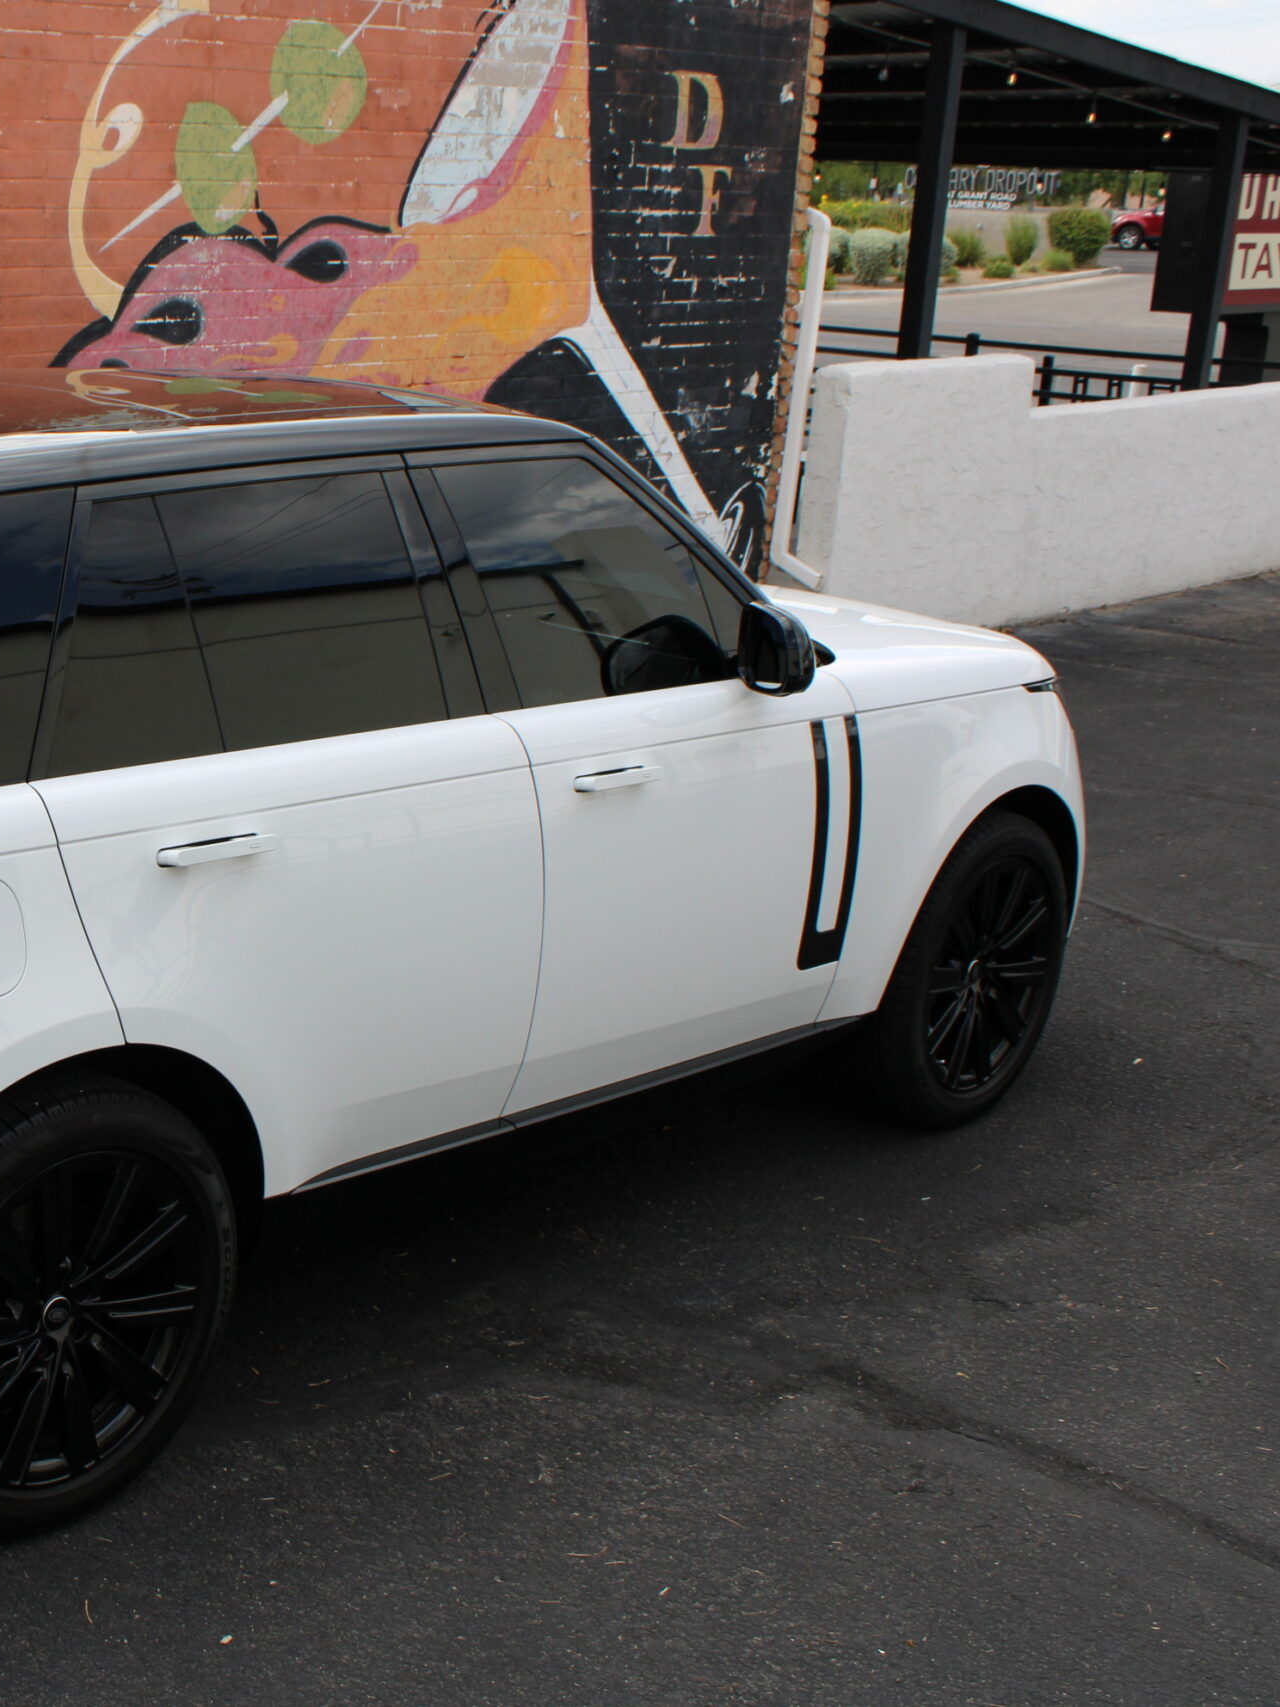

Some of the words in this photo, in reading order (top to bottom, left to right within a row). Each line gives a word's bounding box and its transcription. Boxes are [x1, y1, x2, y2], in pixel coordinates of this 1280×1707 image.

[661, 70, 724, 149] D
[984, 169, 1062, 195] DROPOUT
[688, 165, 733, 236] F
[948, 199, 984, 208] LUMBER
[985, 201, 1011, 210] YARD
[956, 191, 988, 199] GRANT
[989, 191, 1017, 201] ROAD
